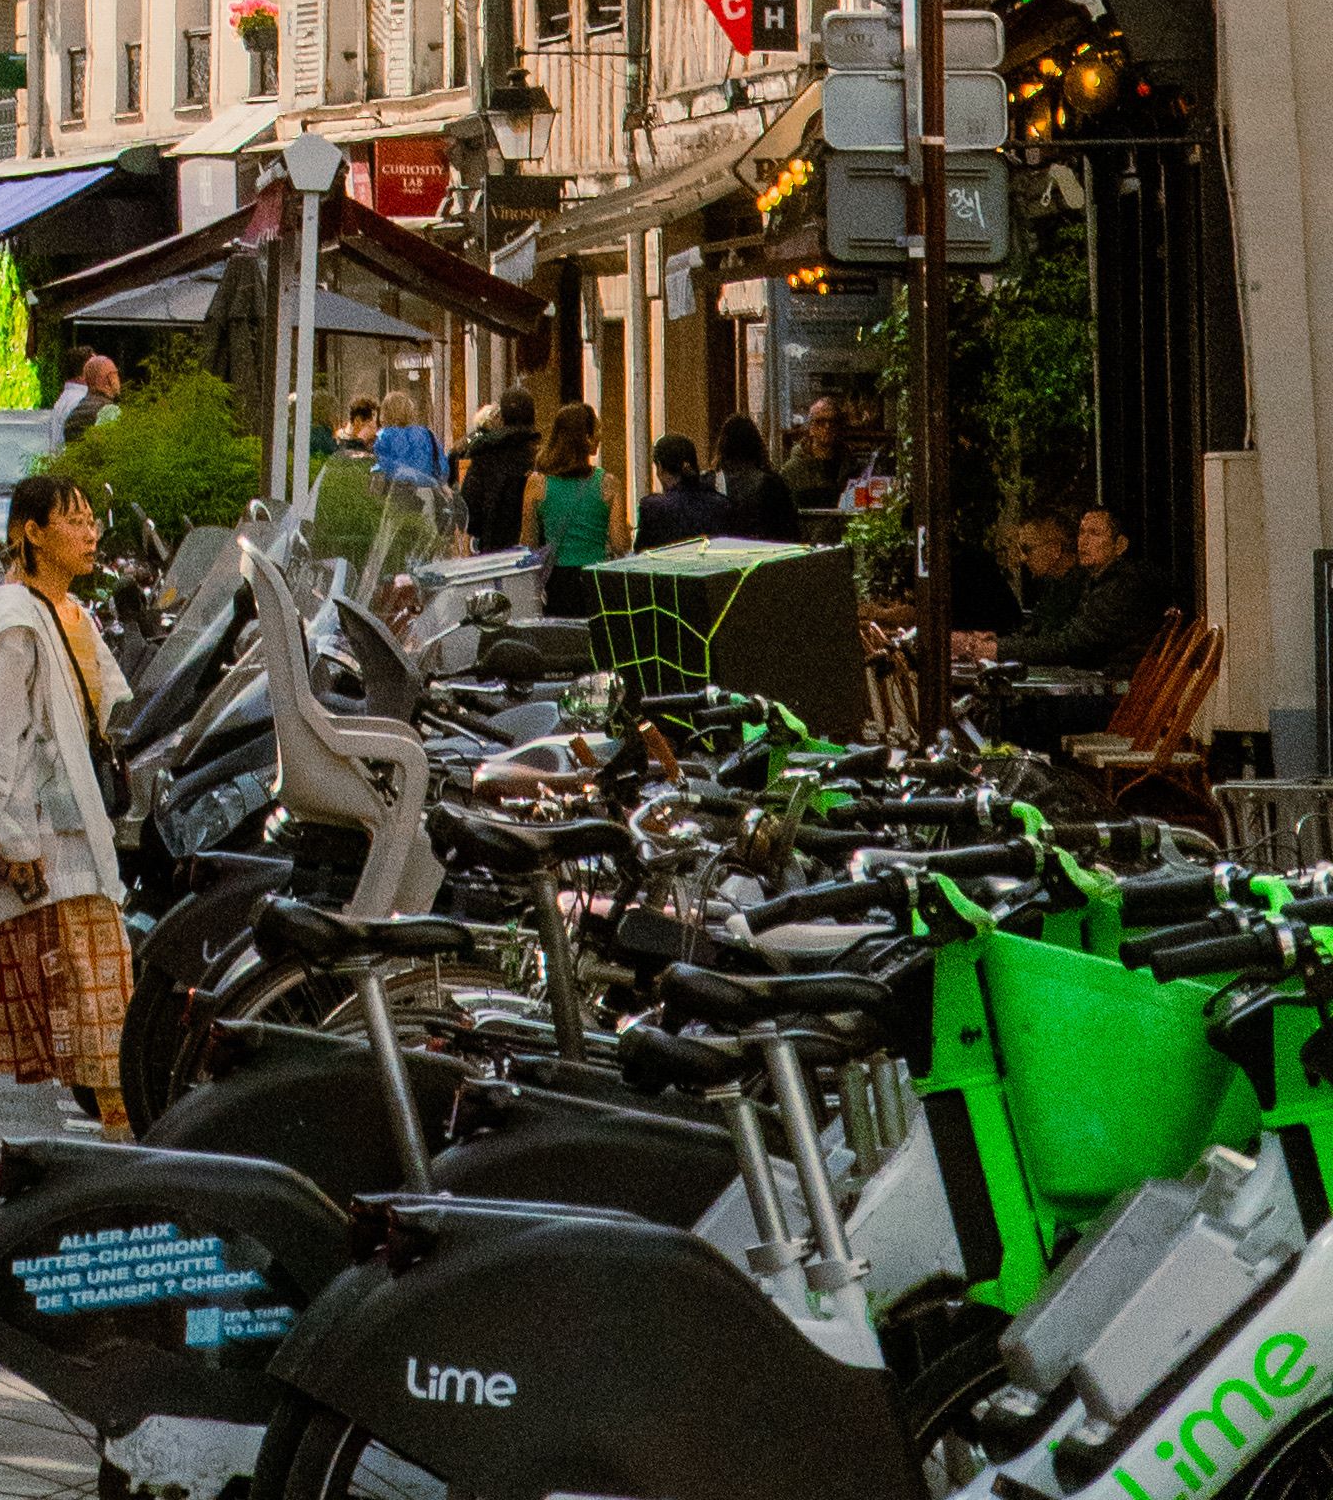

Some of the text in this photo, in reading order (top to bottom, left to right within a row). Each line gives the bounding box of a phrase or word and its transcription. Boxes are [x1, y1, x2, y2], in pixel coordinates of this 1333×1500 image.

[381, 163, 444, 176] CURIOSITY
[402, 177, 424, 187] LAB
[59, 1223, 171, 1251] ALLER AUX
[12, 1237, 219, 1275] BUTTES-CHAUMONT
[25, 1256, 217, 1292] SANS UNE GOUTTE
[36, 1295, 64, 1311] DE
[69, 1282, 158, 1306] TRANSPI
[165, 1279, 176, 1293] ?
[224, 1324, 243, 1336] TO
[407, 1357, 517, 1407] Lime
